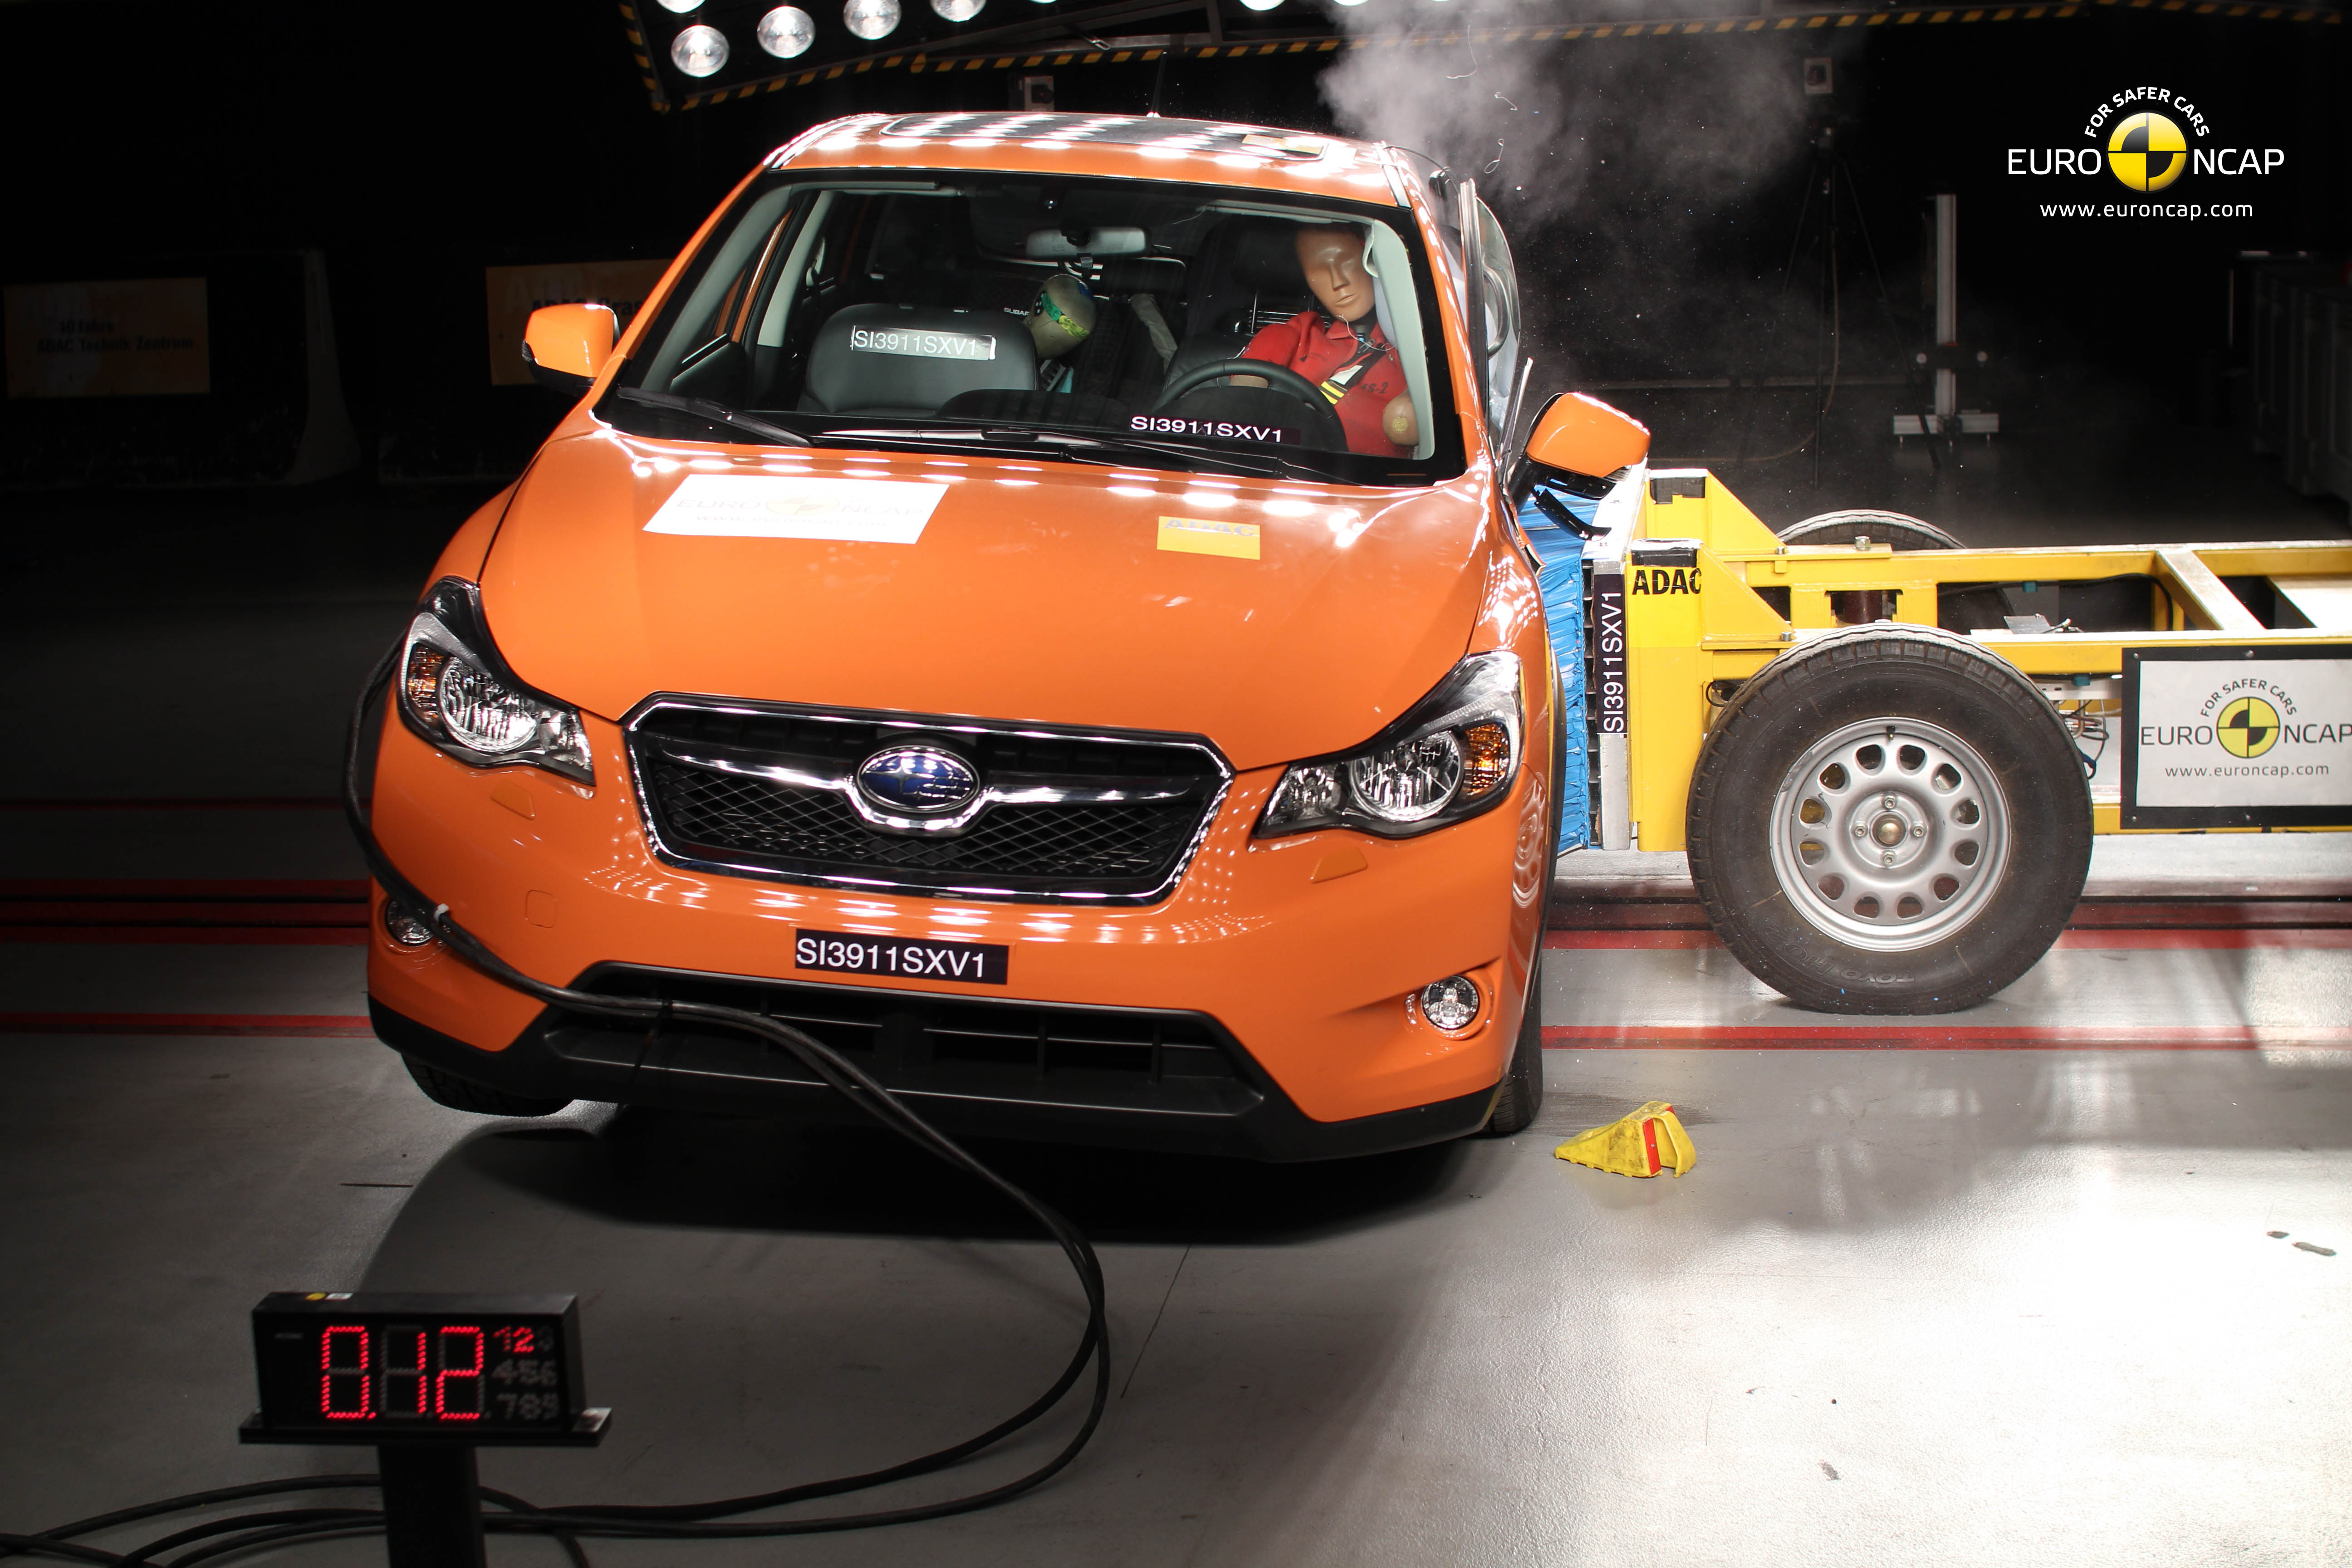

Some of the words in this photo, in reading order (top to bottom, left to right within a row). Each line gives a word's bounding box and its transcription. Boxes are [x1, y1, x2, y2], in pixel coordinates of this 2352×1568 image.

[37, 338, 74, 353] ADAC
[79, 337, 130, 353] Technik
[136, 335, 194, 351] Zentrum
[854, 330, 977, 356] SI3911SXV1
[1131, 416, 1281, 443] SI3911SXV1
[1165, 519, 1255, 536] ADAC
[1632, 568, 1702, 595] ADAC
[1600, 592, 1624, 733] SI3911SXV1
[2200, 691, 2222, 717] FOR
[2222, 678, 2267, 695] SAFER
[2270, 685, 2297, 715] CARS
[2141, 725, 2213, 745] EURO
[2284, 724, 2352, 743] NCAP
[2165, 764, 2329, 778] www.euroncap.com
[796, 937, 984, 978] SI3911SXV1
[1840, 968, 1915, 984] TOYO
